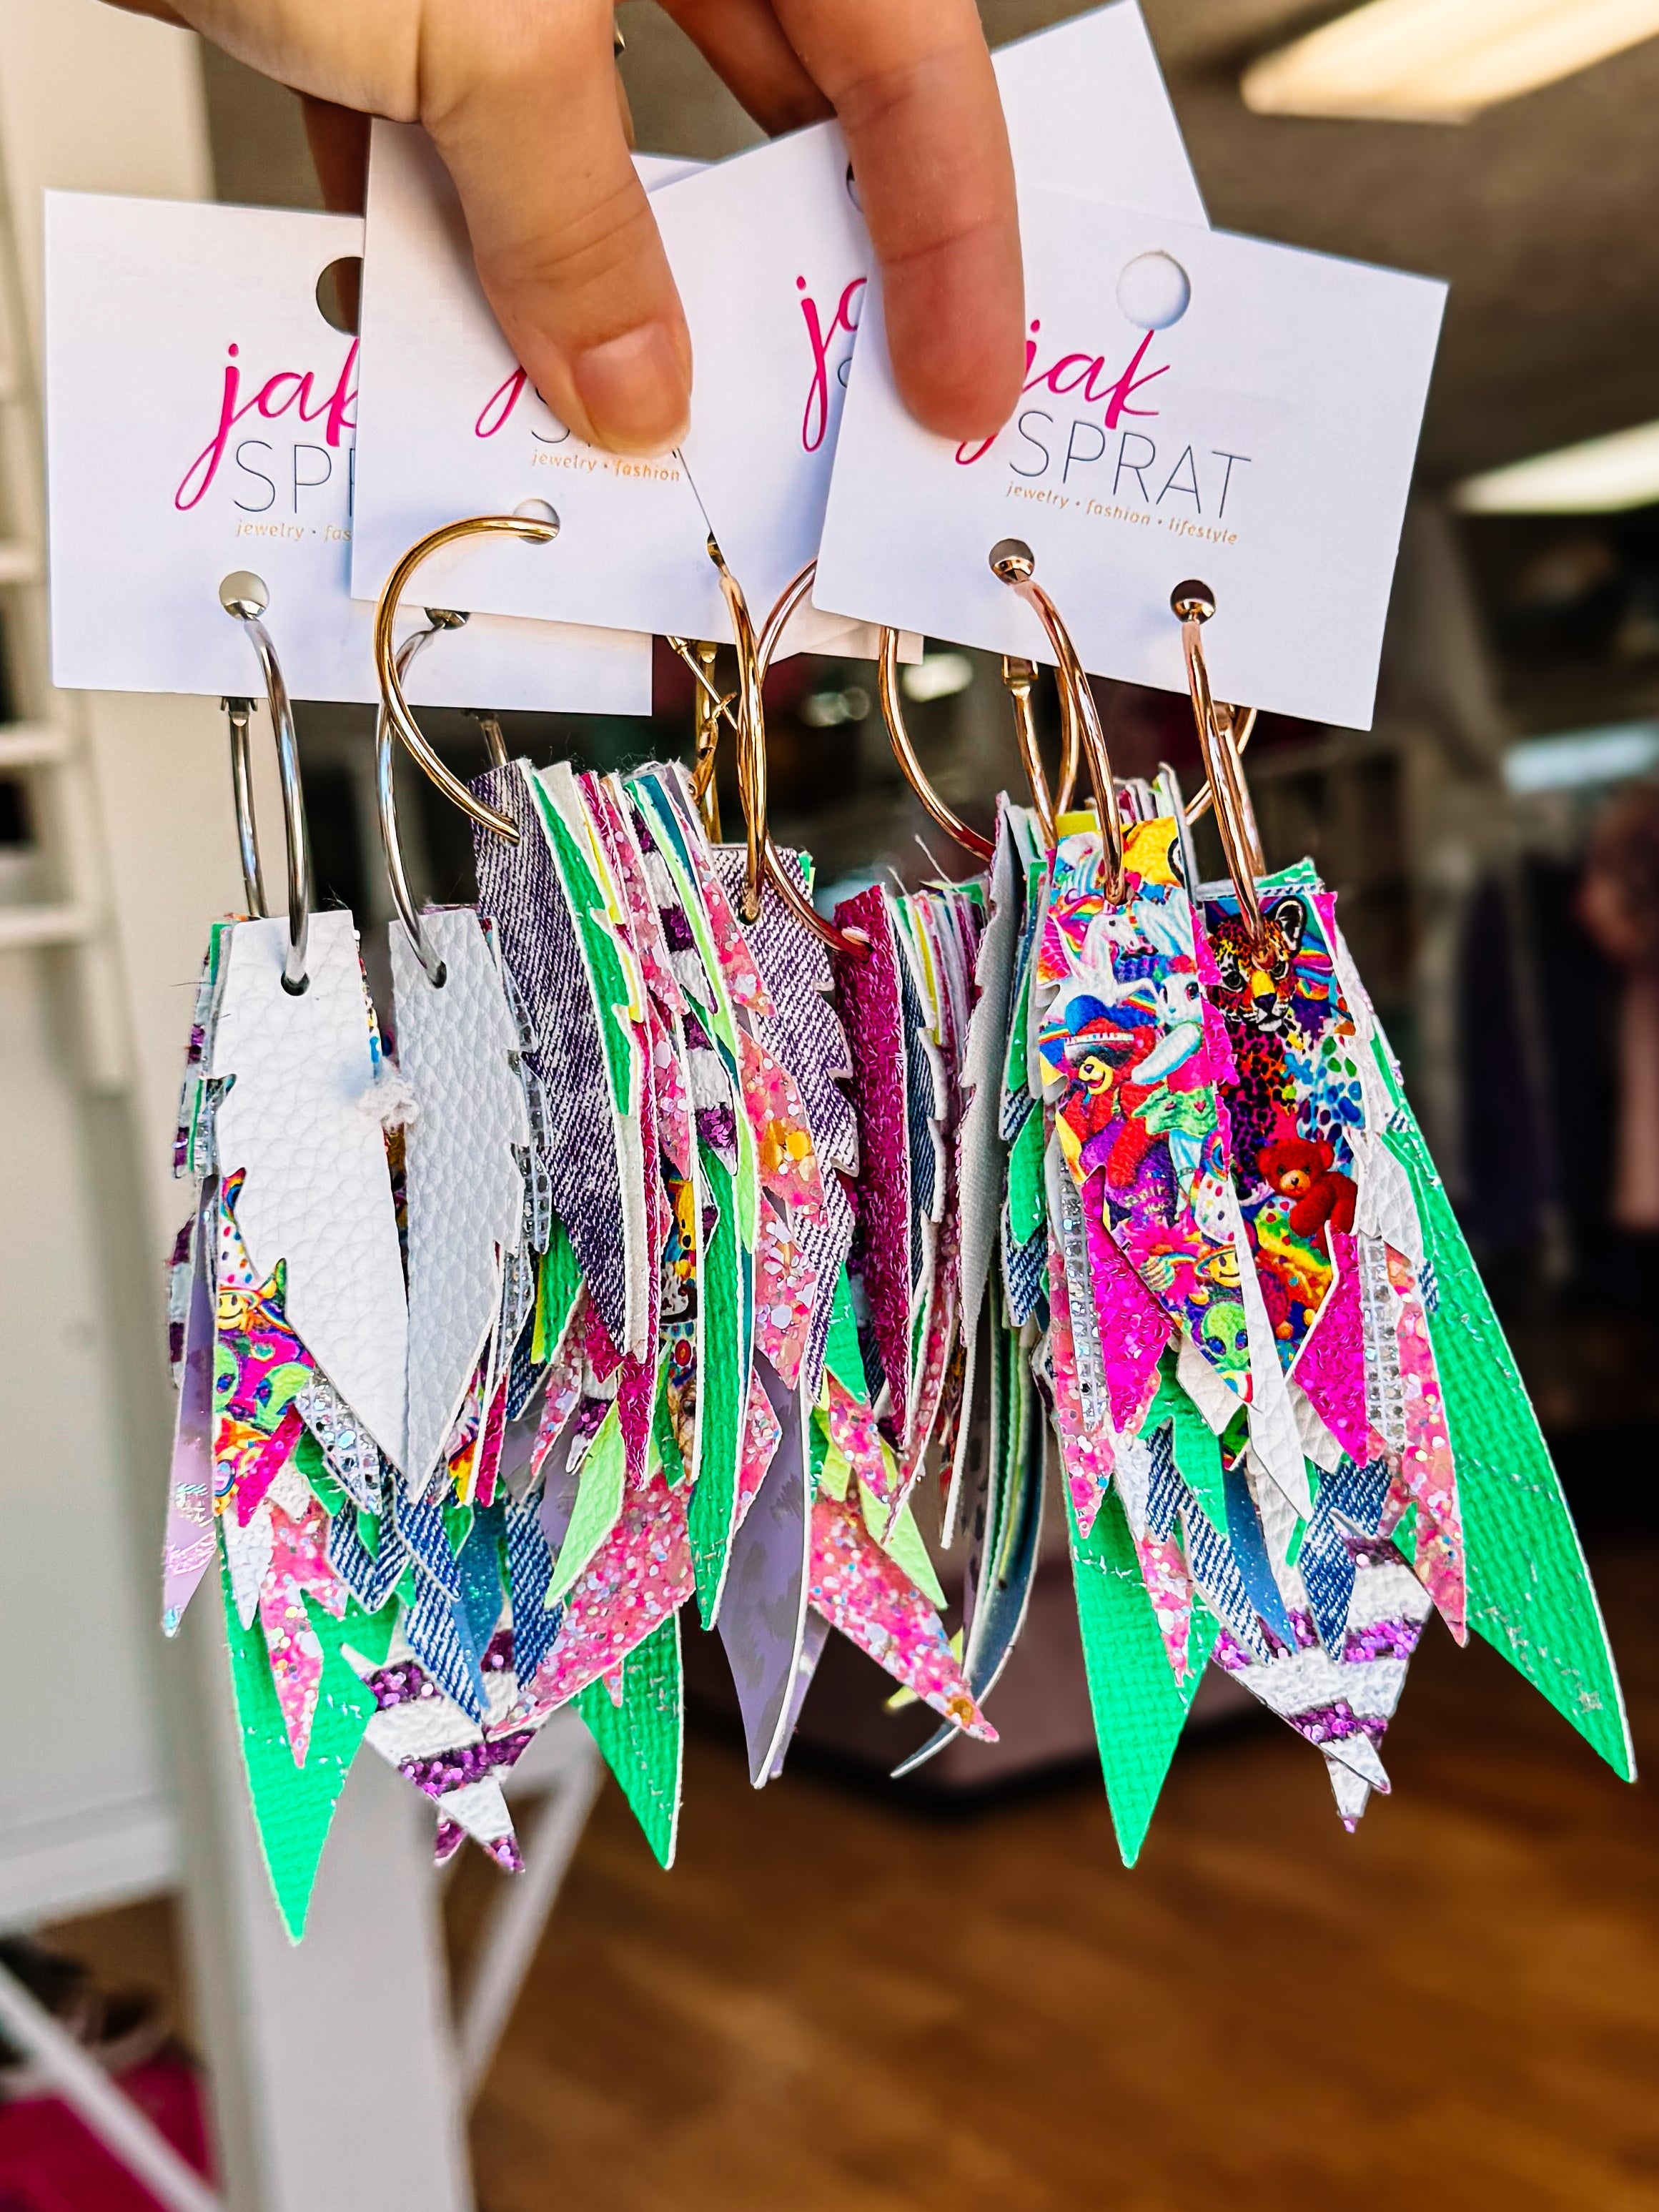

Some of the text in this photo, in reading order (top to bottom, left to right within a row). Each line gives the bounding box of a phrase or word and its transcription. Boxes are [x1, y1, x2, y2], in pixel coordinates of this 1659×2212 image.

[531, 450, 680, 482] jewelry fashion
[1009, 410, 1252, 518] SPRAT
[236, 520, 305, 541] jewelry
[1006, 480, 1239, 545] jewelry fashion lifestyle
